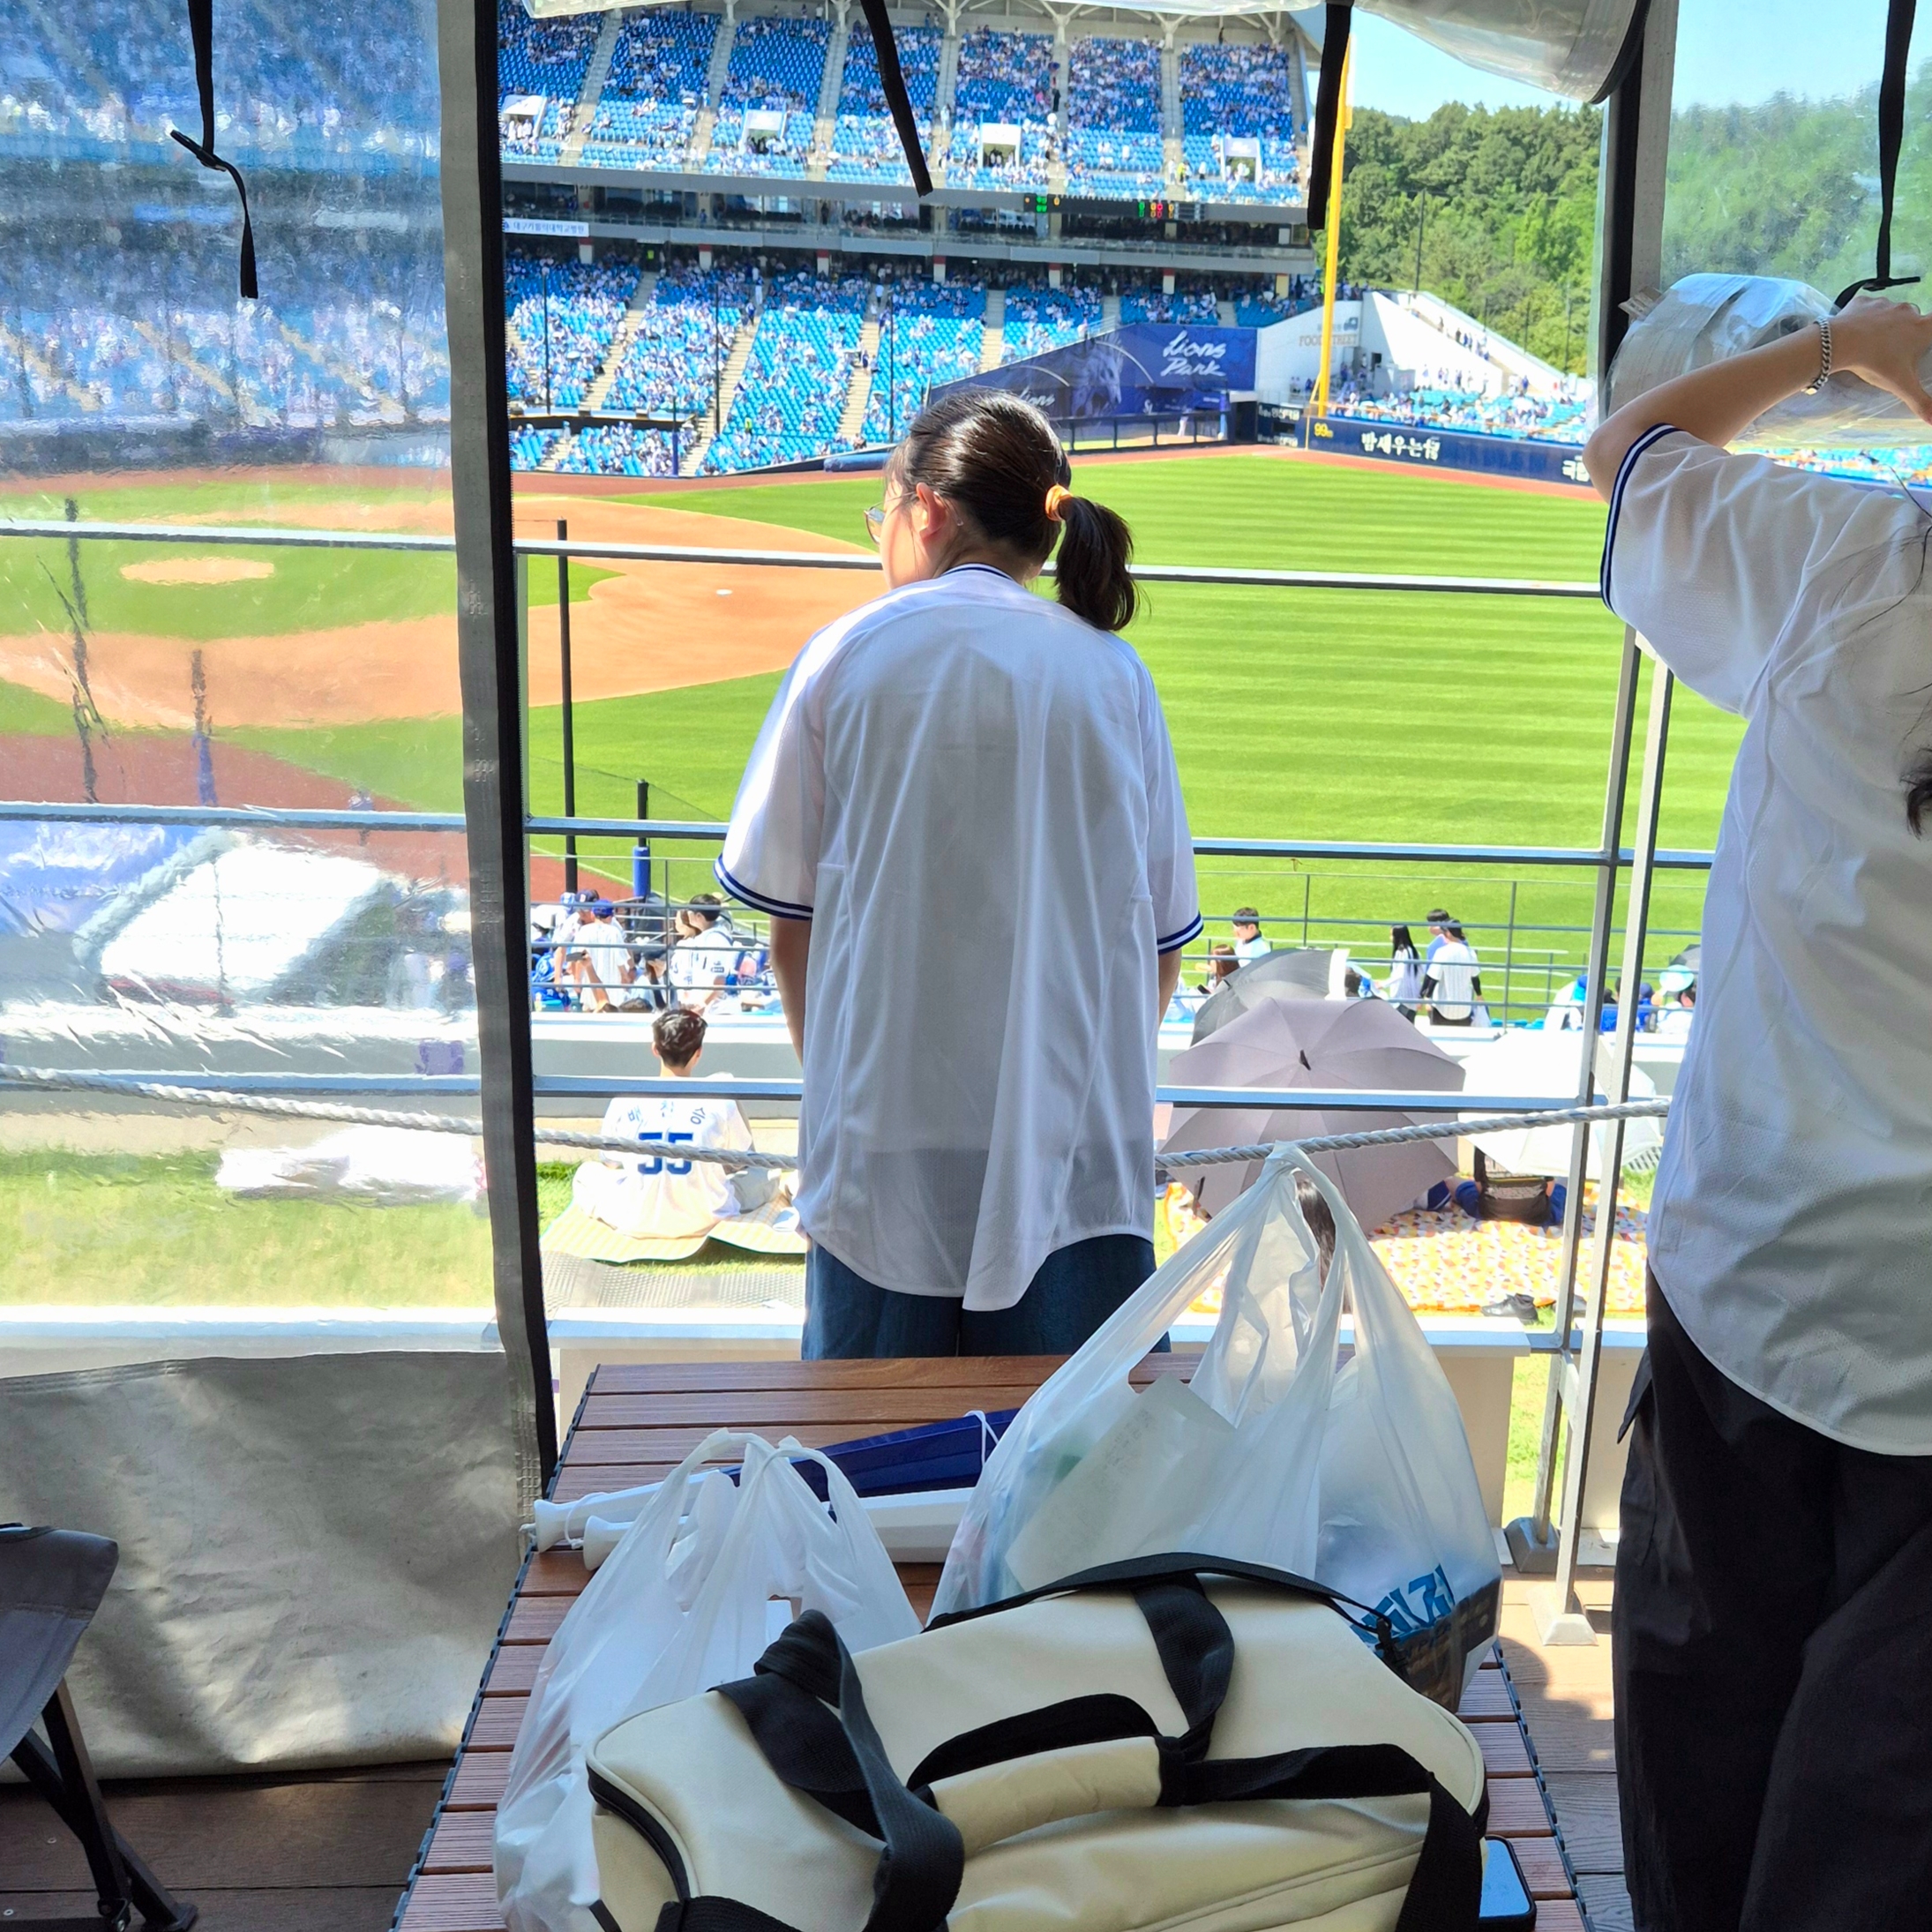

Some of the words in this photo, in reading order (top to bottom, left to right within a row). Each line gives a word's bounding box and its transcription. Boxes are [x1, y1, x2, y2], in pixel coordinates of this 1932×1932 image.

[1163, 330, 1226, 357] Lions
[1299, 334, 1322, 346] FOO
[1160, 356, 1226, 377] Park
[637, 1132, 693, 1175] 55
